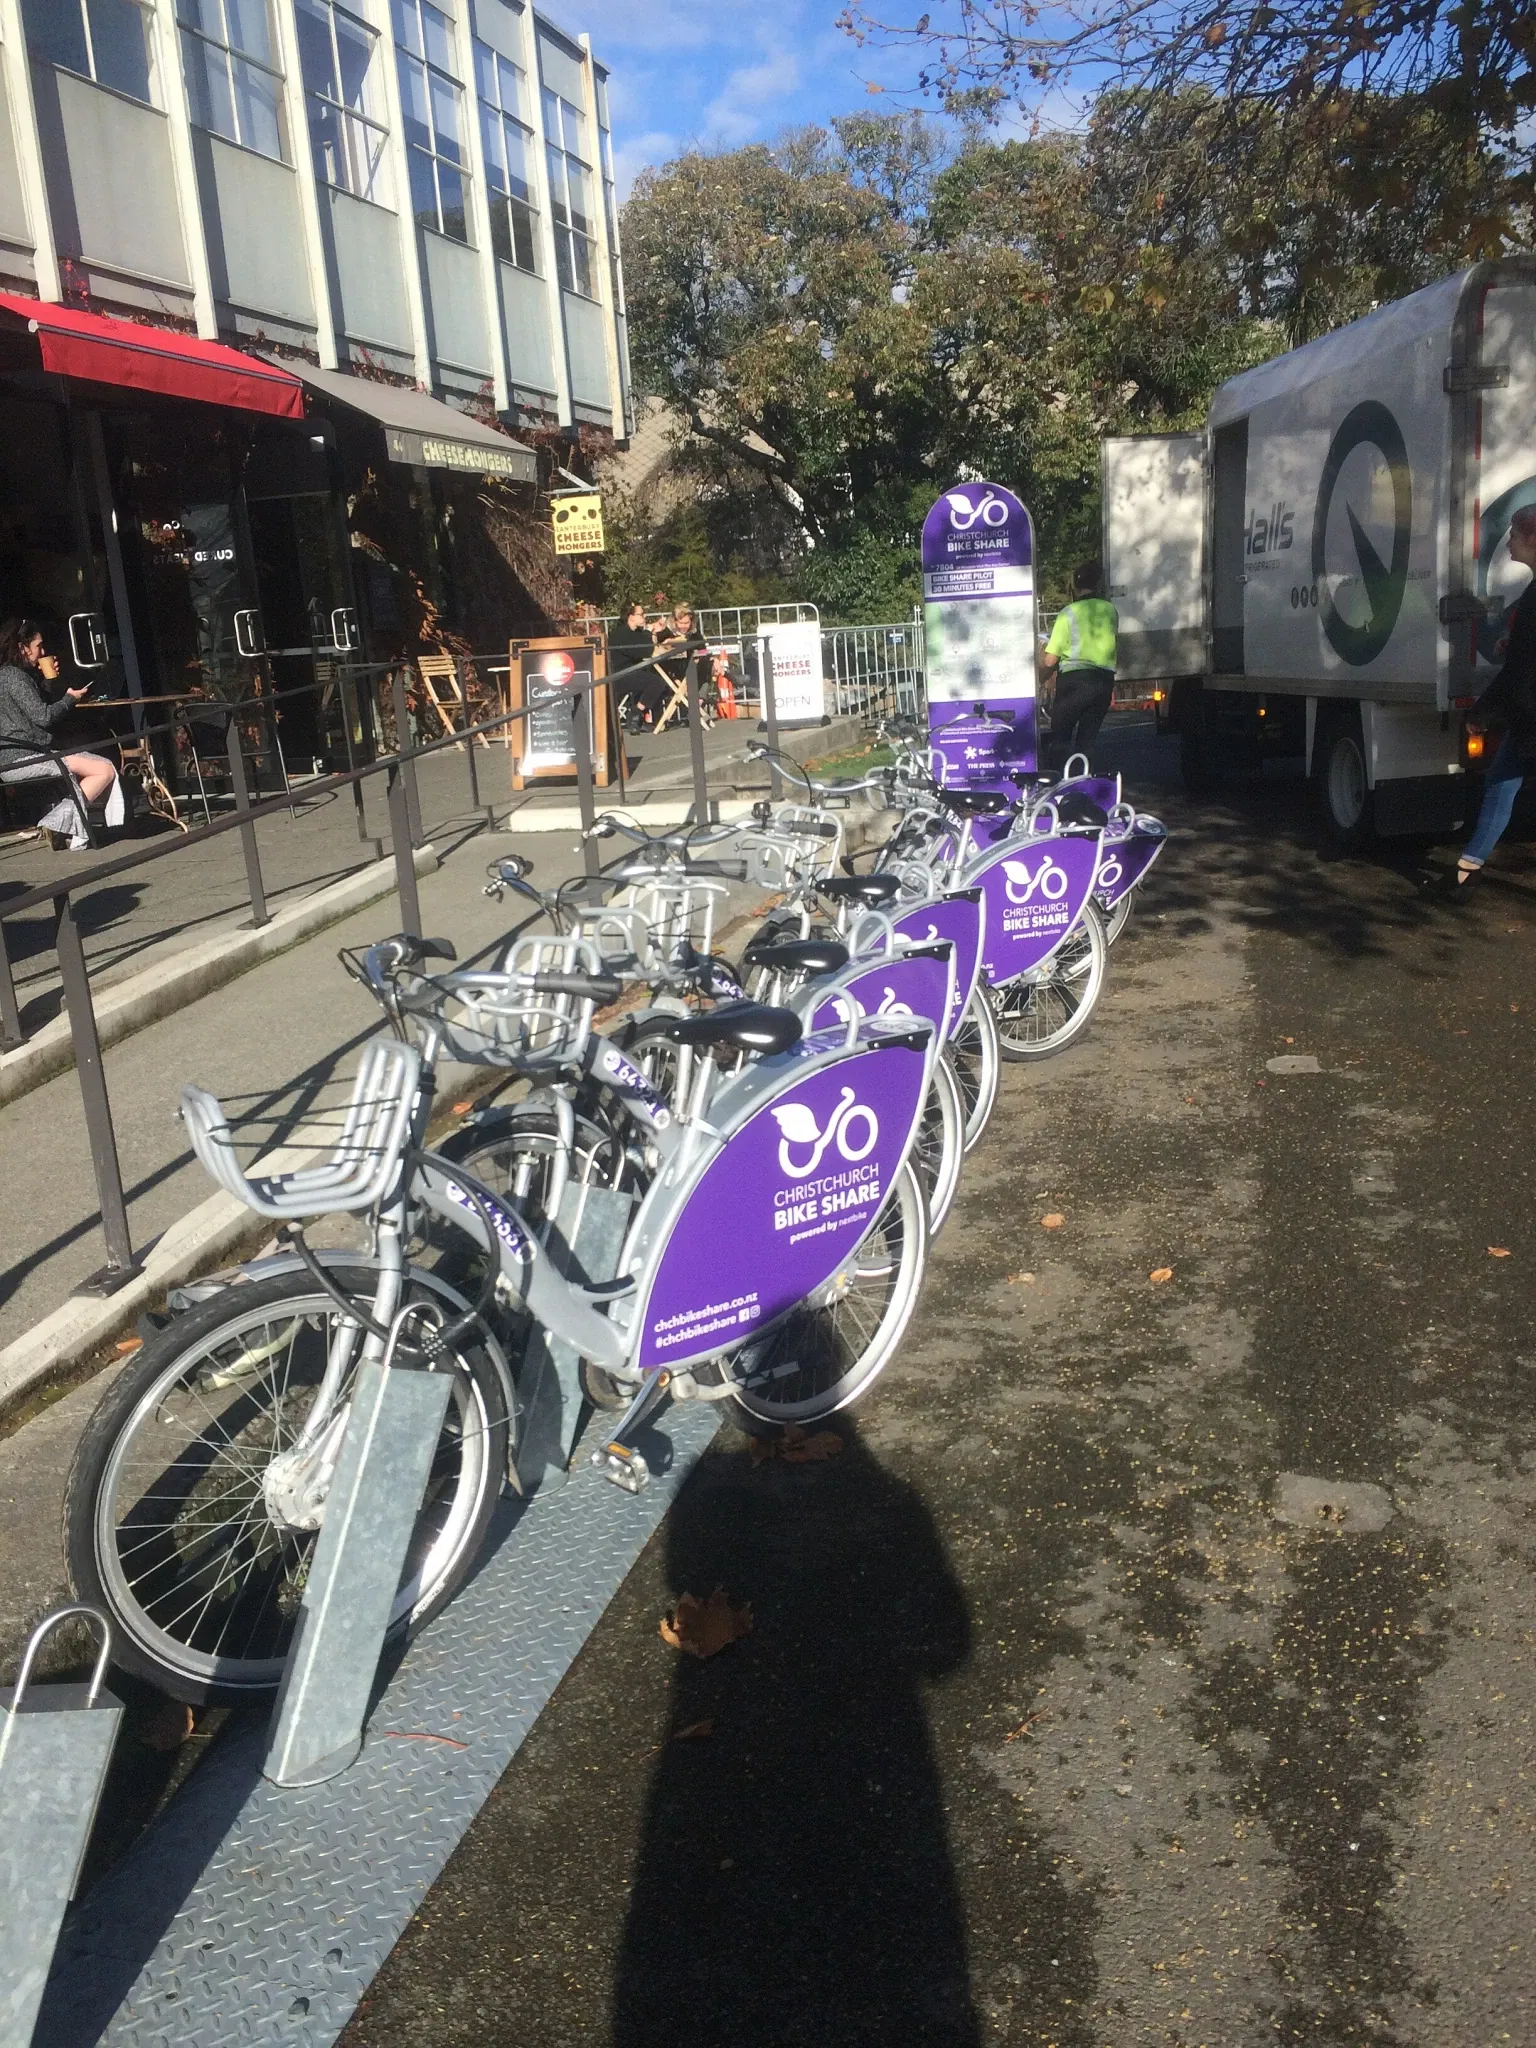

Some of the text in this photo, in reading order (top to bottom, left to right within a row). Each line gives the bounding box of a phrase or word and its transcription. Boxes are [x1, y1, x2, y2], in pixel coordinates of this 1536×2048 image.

[423, 441, 513, 473] CHEESEMONGERS
[557, 531, 601, 542] CHEESE
[947, 530, 1009, 541] CHRISTCHURCH
[558, 541, 602, 551] MONGERS
[947, 538, 1010, 552] BIKE SHARE
[936, 563, 954, 571] 7804
[932, 571, 993, 583] BIKE SHARE PILOT
[943, 584, 974, 592] MINUTES
[974, 582, 991, 590] FREE
[775, 696, 811, 709] OPEN
[978, 748, 996, 756] Spark
[1003, 902, 1069, 918] CHRISTCHURCH
[1003, 912, 1069, 931] BIKE SHARE
[1012, 932, 1035, 941] powered
[774, 1162, 879, 1207] CHRISTCHURCH
[774, 1181, 880, 1231] BIKE SHARE
[790, 1211, 867, 1245] powered by nextbike
[654, 1292, 758, 1333] chchbikeshare.co.nz
[655, 1315, 737, 1349] #chchbikeshare
